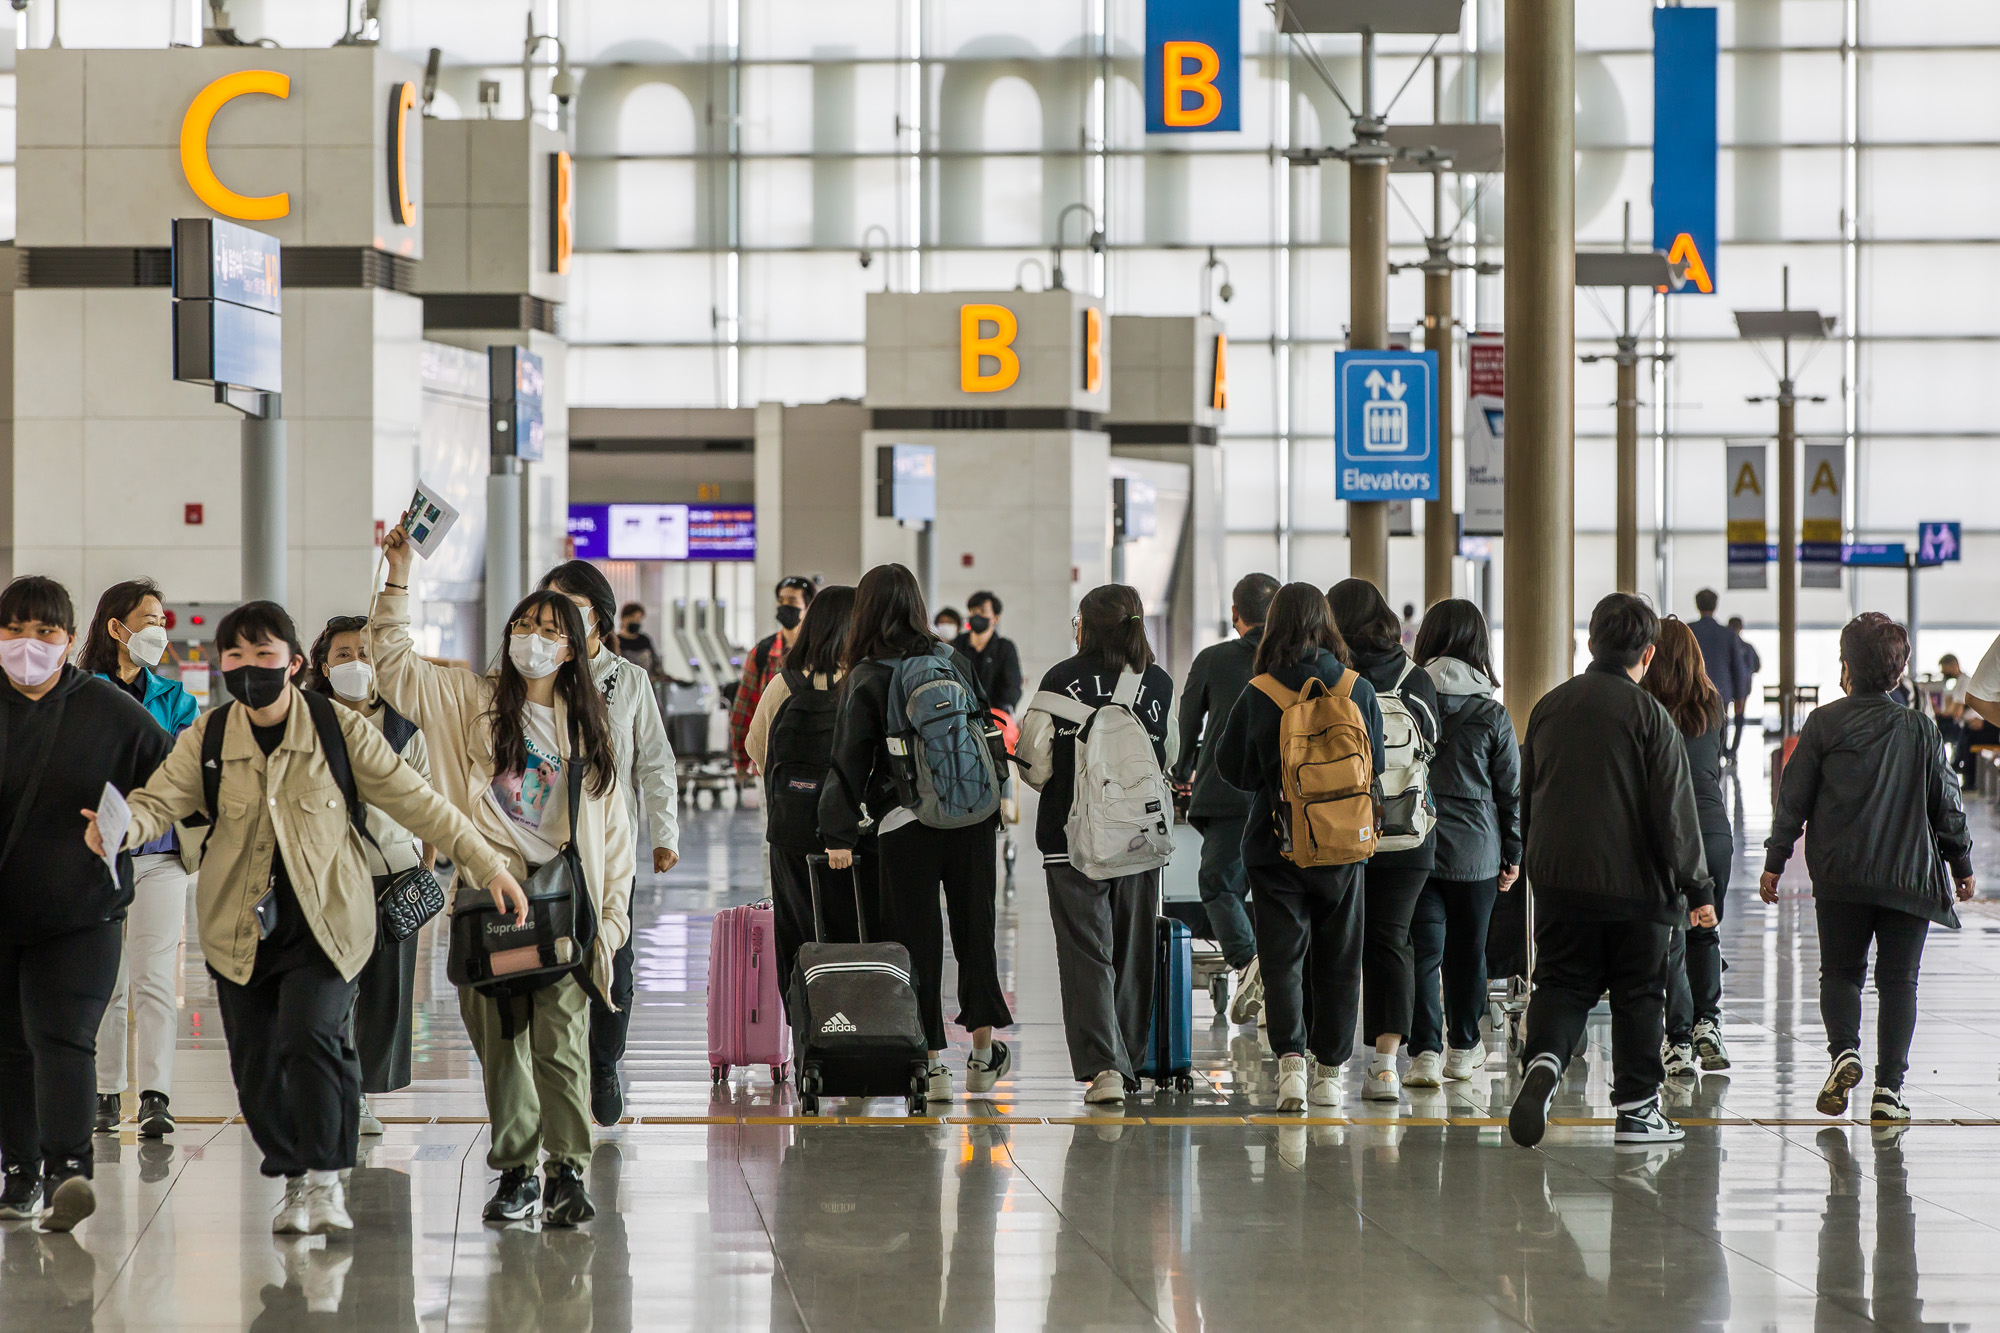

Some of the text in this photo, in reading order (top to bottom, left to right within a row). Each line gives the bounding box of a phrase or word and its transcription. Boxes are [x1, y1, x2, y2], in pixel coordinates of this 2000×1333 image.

[1164, 41, 1221, 126] B
[180, 69, 291, 220] C
[397, 81, 416, 227] C
[1655, 232, 1713, 293] A
[961, 304, 1019, 392] B
[1087, 306, 1103, 394] B
[1343, 468, 1430, 491] Elevators
[1733, 460, 1761, 497] A
[1810, 459, 1838, 497] A
[821, 1023, 857, 1033] adidas
